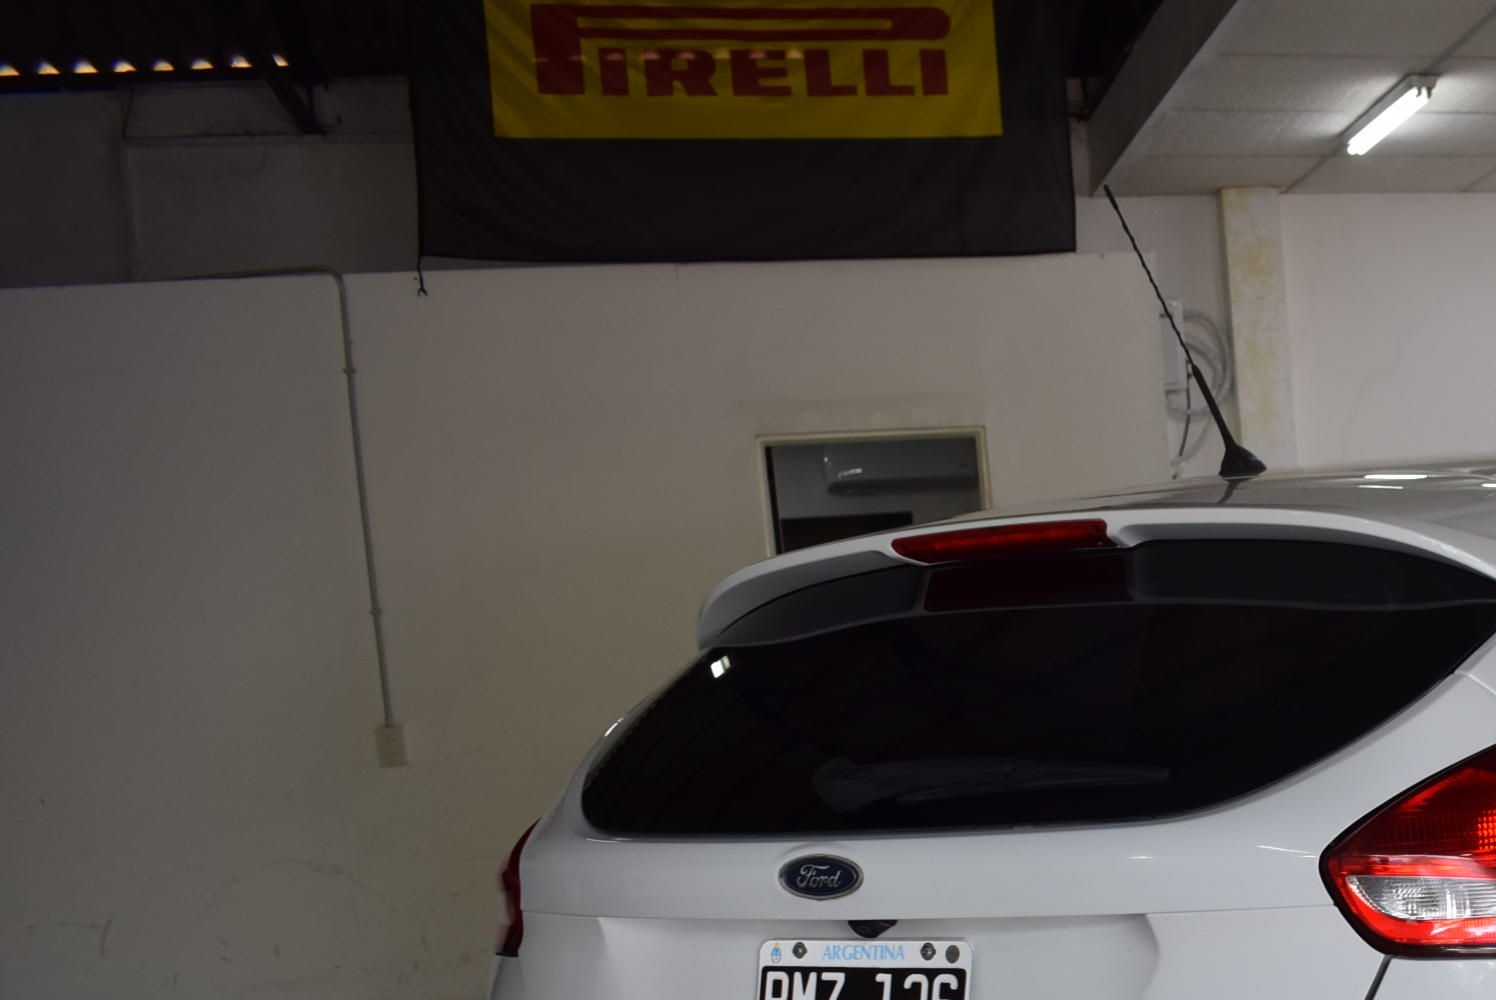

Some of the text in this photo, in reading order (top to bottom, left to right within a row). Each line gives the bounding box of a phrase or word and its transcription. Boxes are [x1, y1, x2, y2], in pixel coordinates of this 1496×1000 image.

[529, 3, 951, 97] PIRELLI
[796, 864, 842, 889] Ford
[822, 944, 906, 961] ARGENTINA
